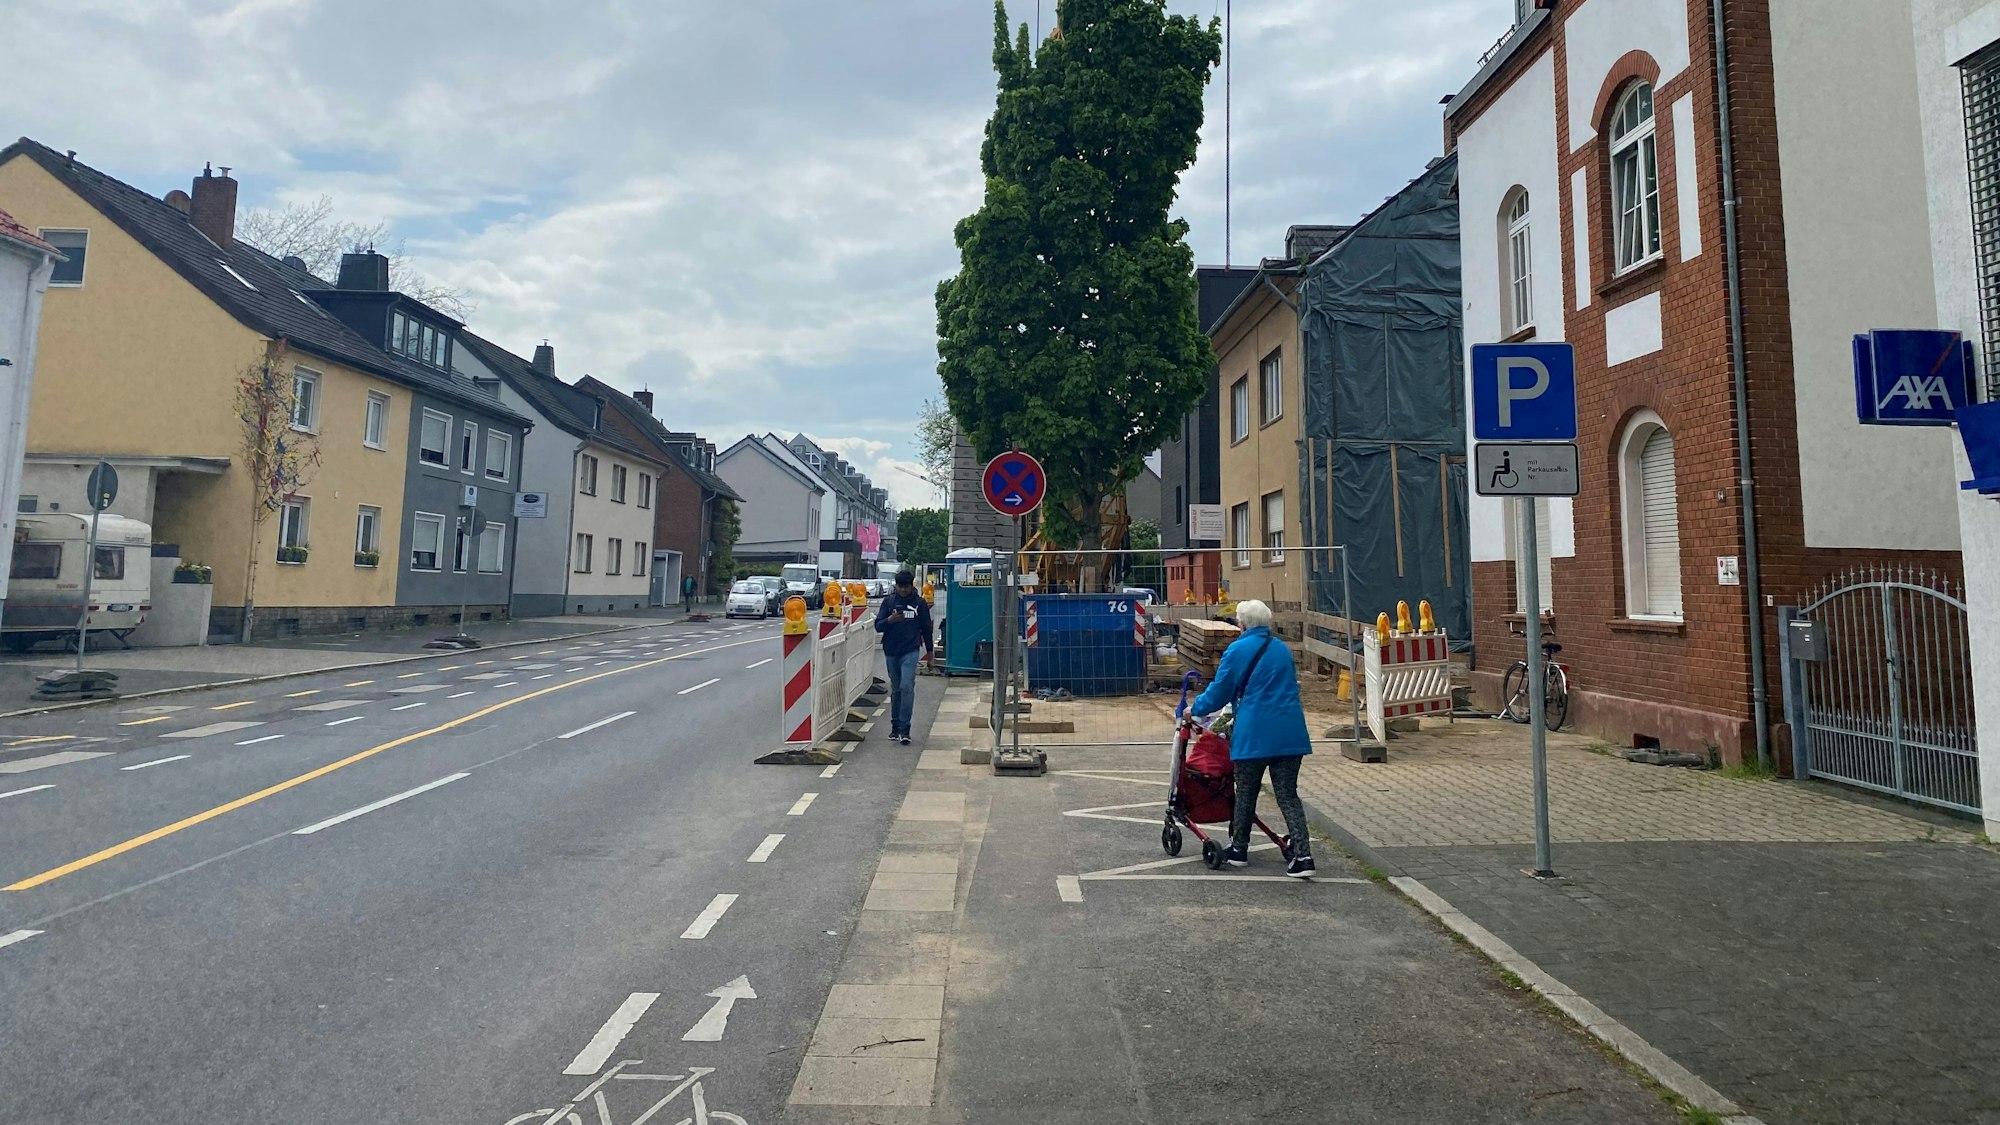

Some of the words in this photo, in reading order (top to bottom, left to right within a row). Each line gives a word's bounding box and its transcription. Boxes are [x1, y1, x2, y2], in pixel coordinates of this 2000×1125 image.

[1497, 356, 1550, 428] P
[1878, 375, 1955, 411] AXA
[1108, 600, 1128, 613] 76
